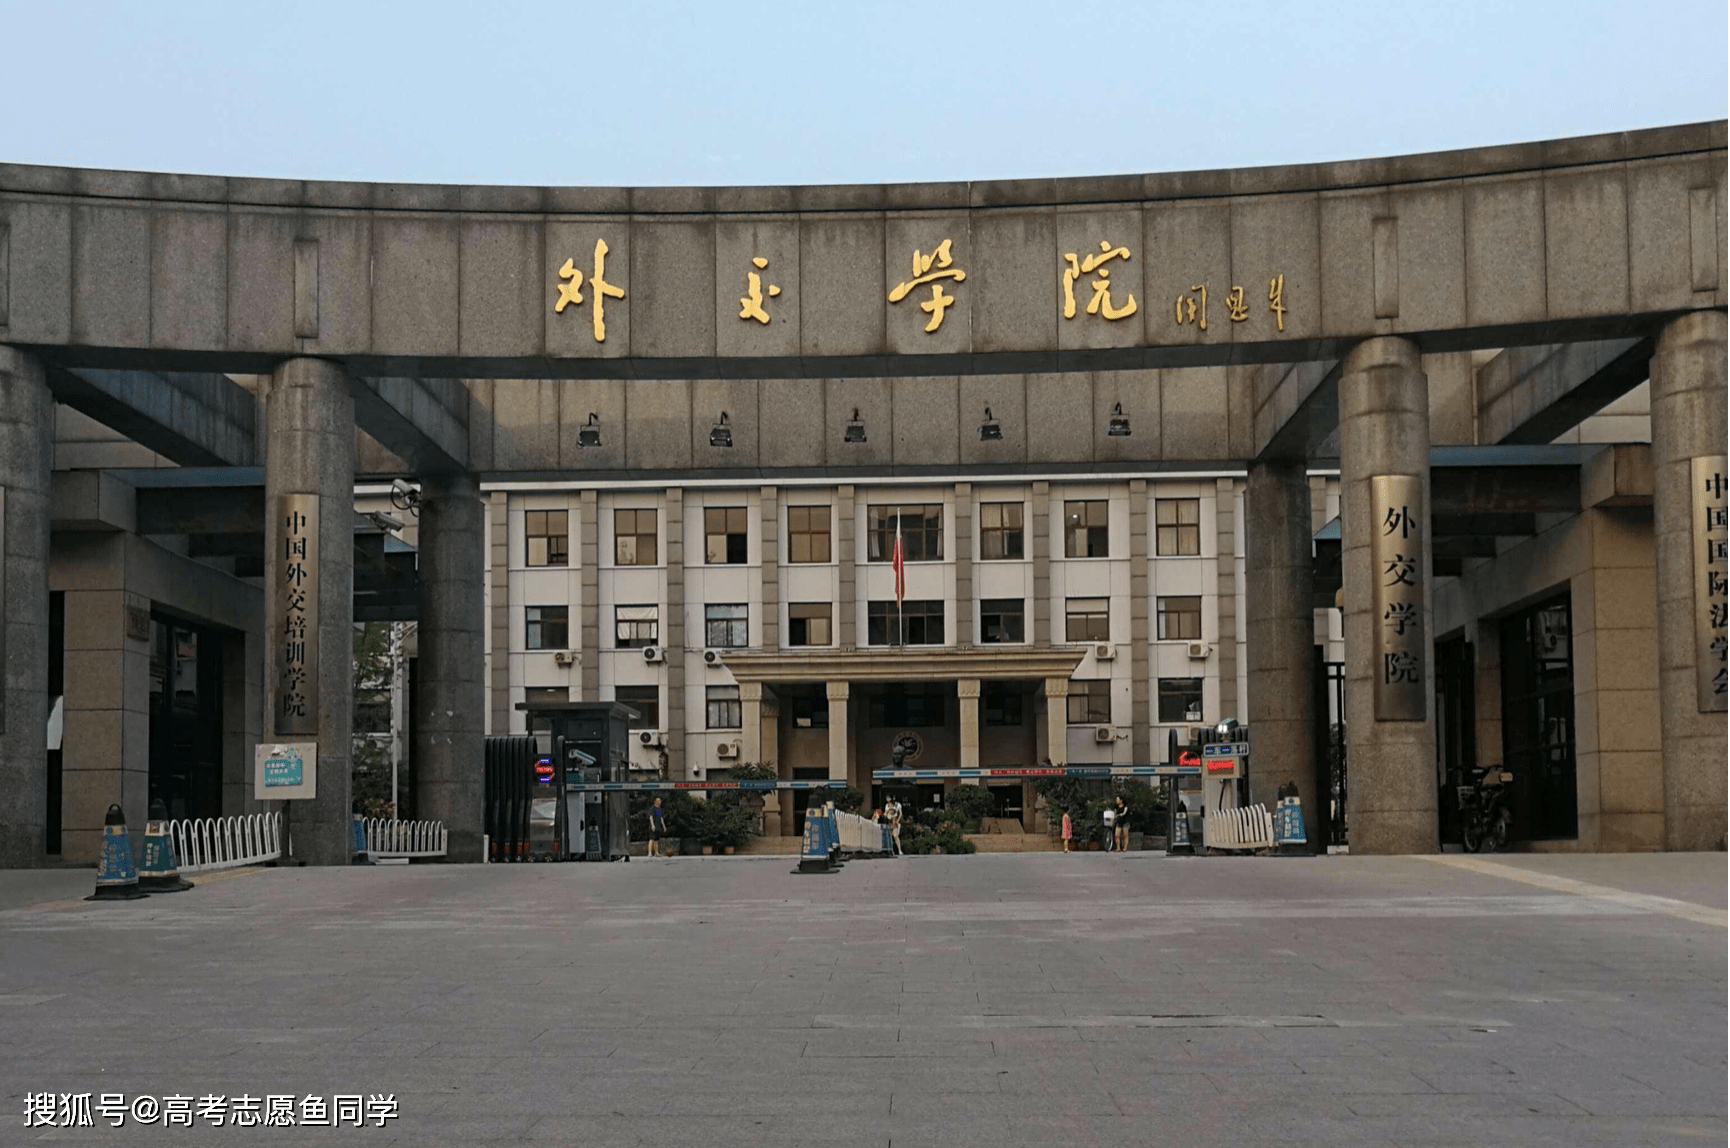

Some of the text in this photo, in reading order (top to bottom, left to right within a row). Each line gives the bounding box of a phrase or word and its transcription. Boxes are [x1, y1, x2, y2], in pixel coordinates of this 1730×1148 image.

[283, 511, 306, 718] 中国外交培训学院
[1383, 506, 1419, 685] 外交学院
